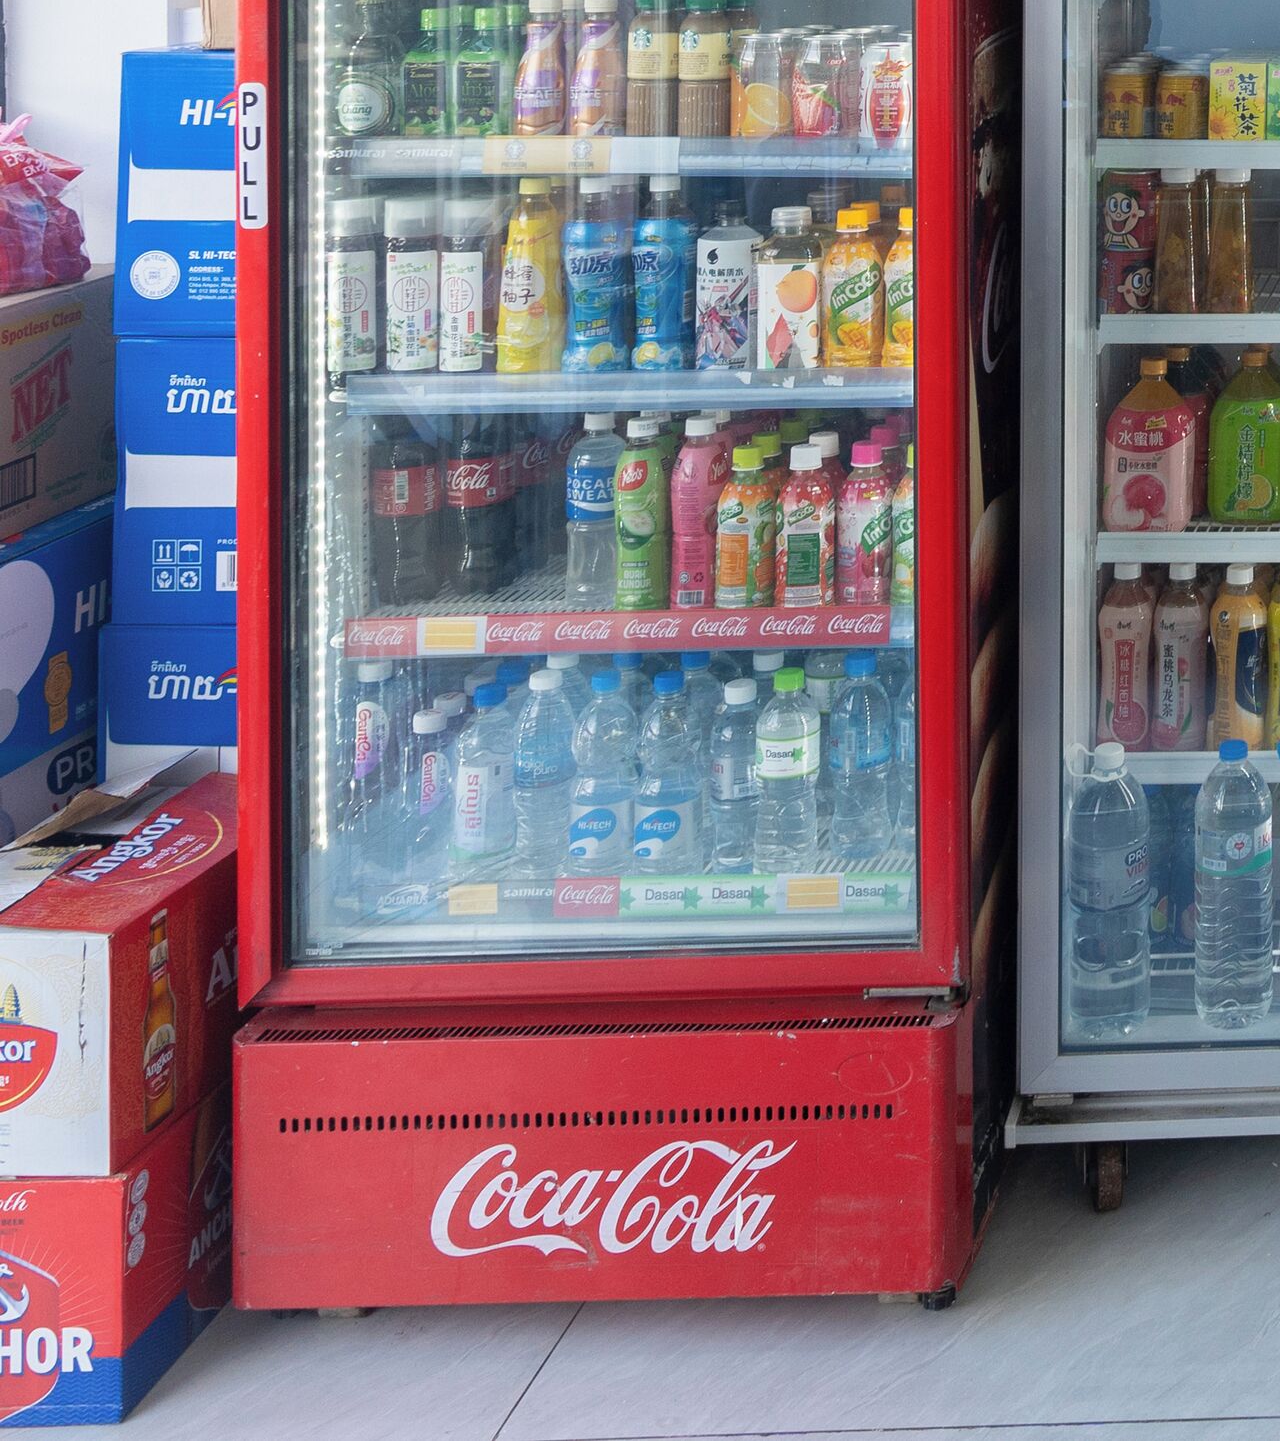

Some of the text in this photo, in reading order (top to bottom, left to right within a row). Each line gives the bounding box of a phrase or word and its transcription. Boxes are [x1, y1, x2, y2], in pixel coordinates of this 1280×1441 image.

[341, 102, 373, 116] Chang
[1234, 72, 1259, 136] 菊花茶
[243, 91, 261, 220] PULL
[189, 250, 201, 260] SL
[189, 266, 224, 274] ADDRESS:
[504, 265, 534, 281] 蜂蜜
[502, 288, 536, 305] 柚子
[1, 310, 82, 345] Spotless Clean
[11, 349, 73, 444] NET
[1118, 430, 1164, 448] 水蜜桃
[349, 625, 408, 647] Coca-Cola
[487, 619, 545, 642] Coca-Cola
[555, 617, 616, 641] Coca-Cola
[1162, 643, 1175, 717] 蜜桃乌龙茶
[578, 819, 612, 831] HI-TECH
[642, 821, 677, 832] HI-TECH
[70, 812, 183, 883] Angkor
[144, 1048, 174, 1080] Angkor
[430, 1140, 798, 1257] Coca-Cola
